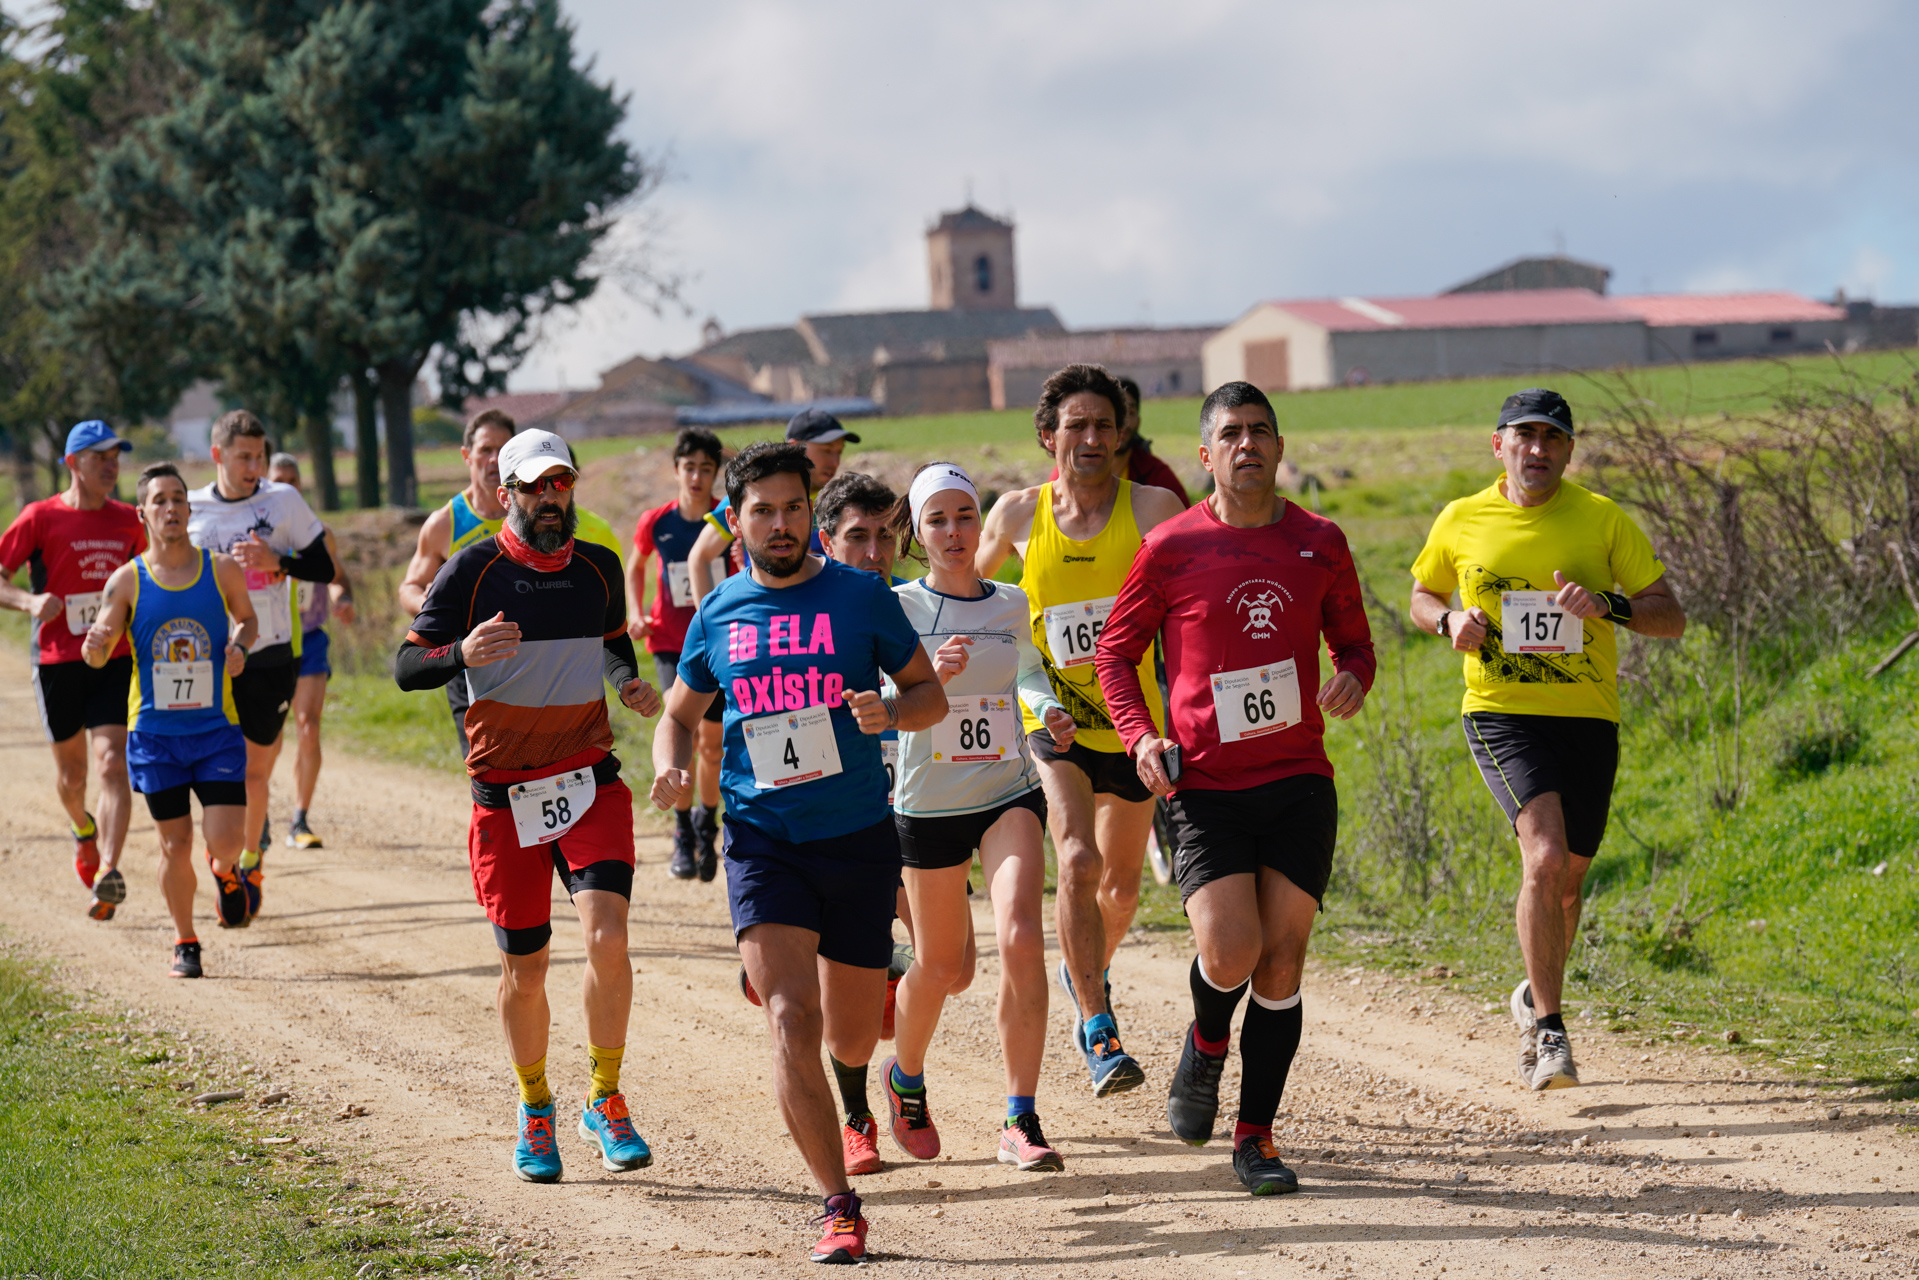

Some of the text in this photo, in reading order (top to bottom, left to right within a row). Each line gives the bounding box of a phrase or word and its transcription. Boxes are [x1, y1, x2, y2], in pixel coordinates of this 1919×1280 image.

[535, 580, 574, 589] LURBEL
[1226, 587, 1239, 604] GRUPO
[1238, 579, 1266, 589] MONTARAZ
[79, 605, 101, 624] 12
[1520, 611, 1563, 641] 157
[728, 613, 836, 662] la ELA
[1272, 665, 1293, 676] Diputación
[1278, 671, 1294, 679] Segovia
[173, 679, 194, 699] 77
[732, 666, 844, 714] existe
[1224, 676, 1249, 685] Diputación
[1243, 689, 1275, 724] 66
[800, 711, 826, 722] Diputación
[808, 717, 827, 726] Segovia
[755, 722, 779, 732] Diputación
[763, 728, 780, 737] Segovia
[960, 717, 991, 750] 86
[783, 737, 800, 770] 4
[529, 790, 547, 799] Segovia
[541, 796, 572, 829] 58
